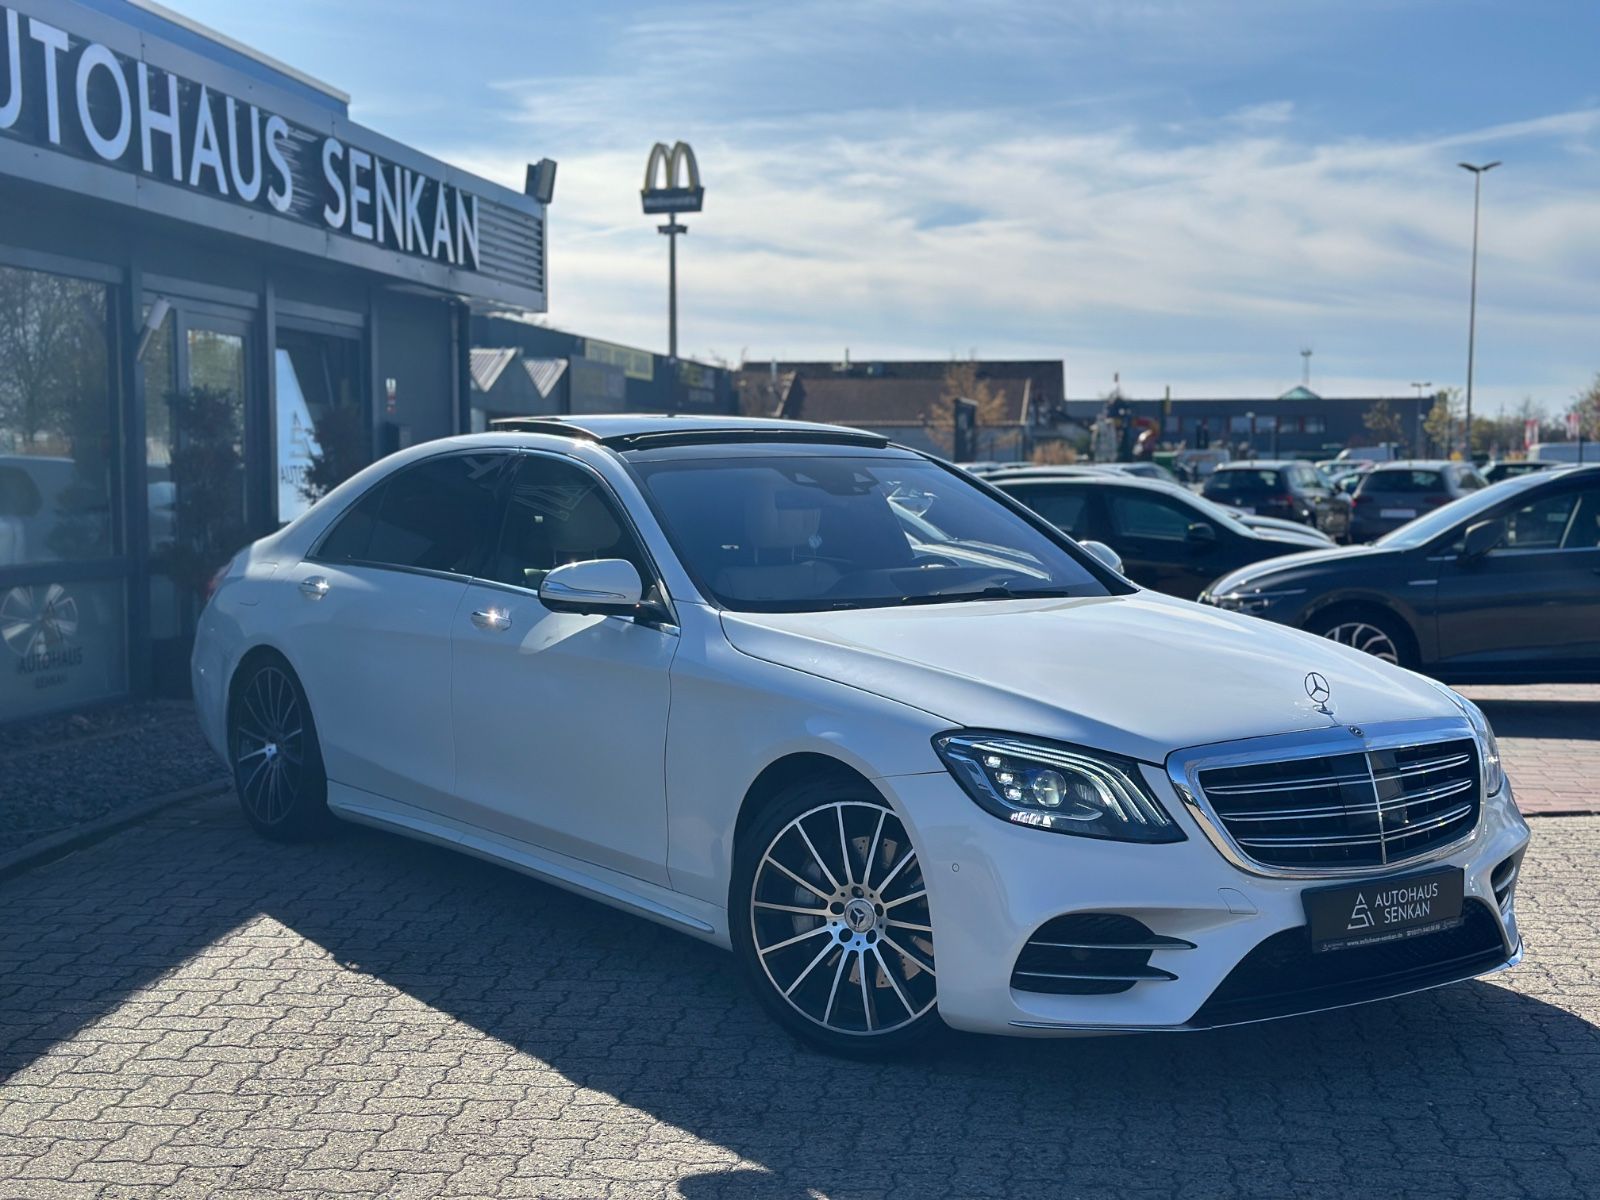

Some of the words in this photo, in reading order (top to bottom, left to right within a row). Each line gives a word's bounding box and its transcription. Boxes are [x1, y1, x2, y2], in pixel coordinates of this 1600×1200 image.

[322, 137, 481, 271] SENKAN
[1375, 883, 1438, 908] AUTOHAUS
[1384, 901, 1430, 924] SENKAN
